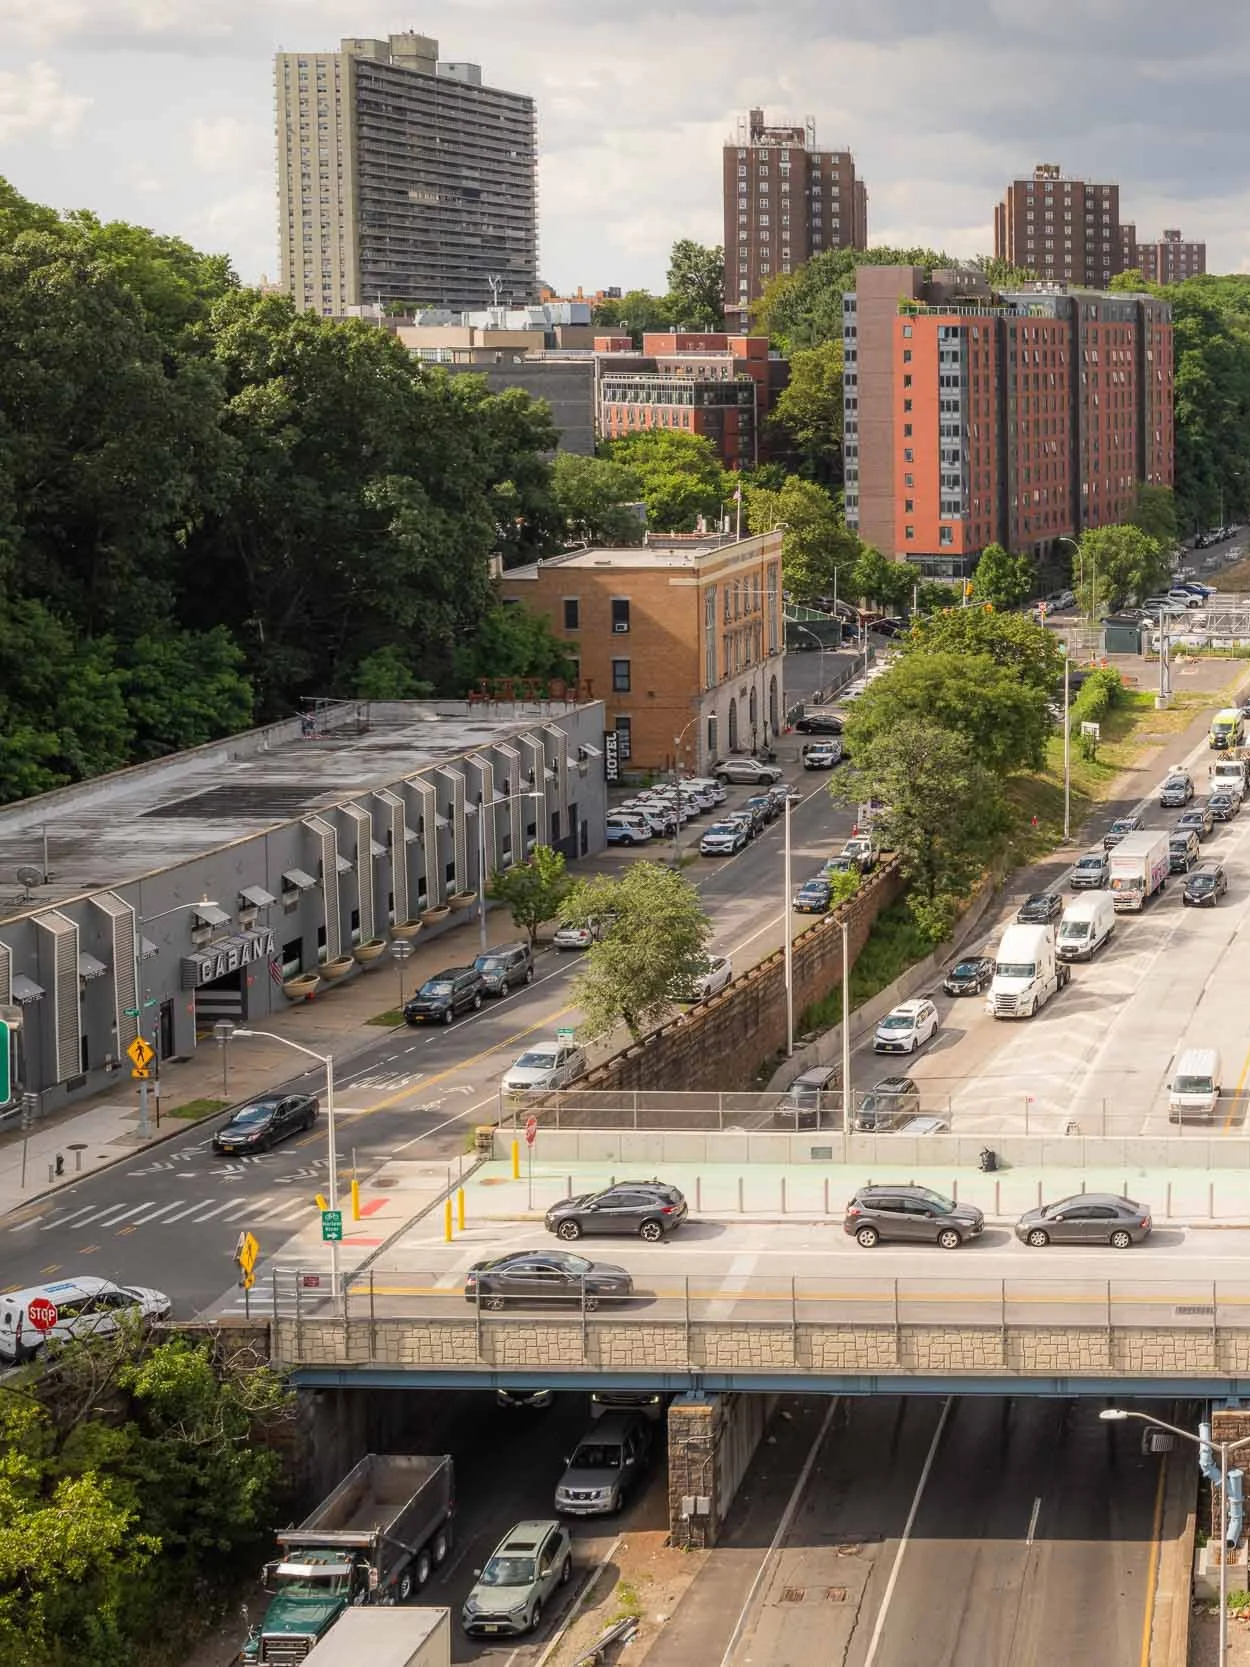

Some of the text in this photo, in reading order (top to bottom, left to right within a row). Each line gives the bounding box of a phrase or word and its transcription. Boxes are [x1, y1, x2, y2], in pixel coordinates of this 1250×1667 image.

[606, 732, 618, 780] HOTEL
[202, 932, 275, 982] CABANA
[30, 1306, 56, 1321] STOP
